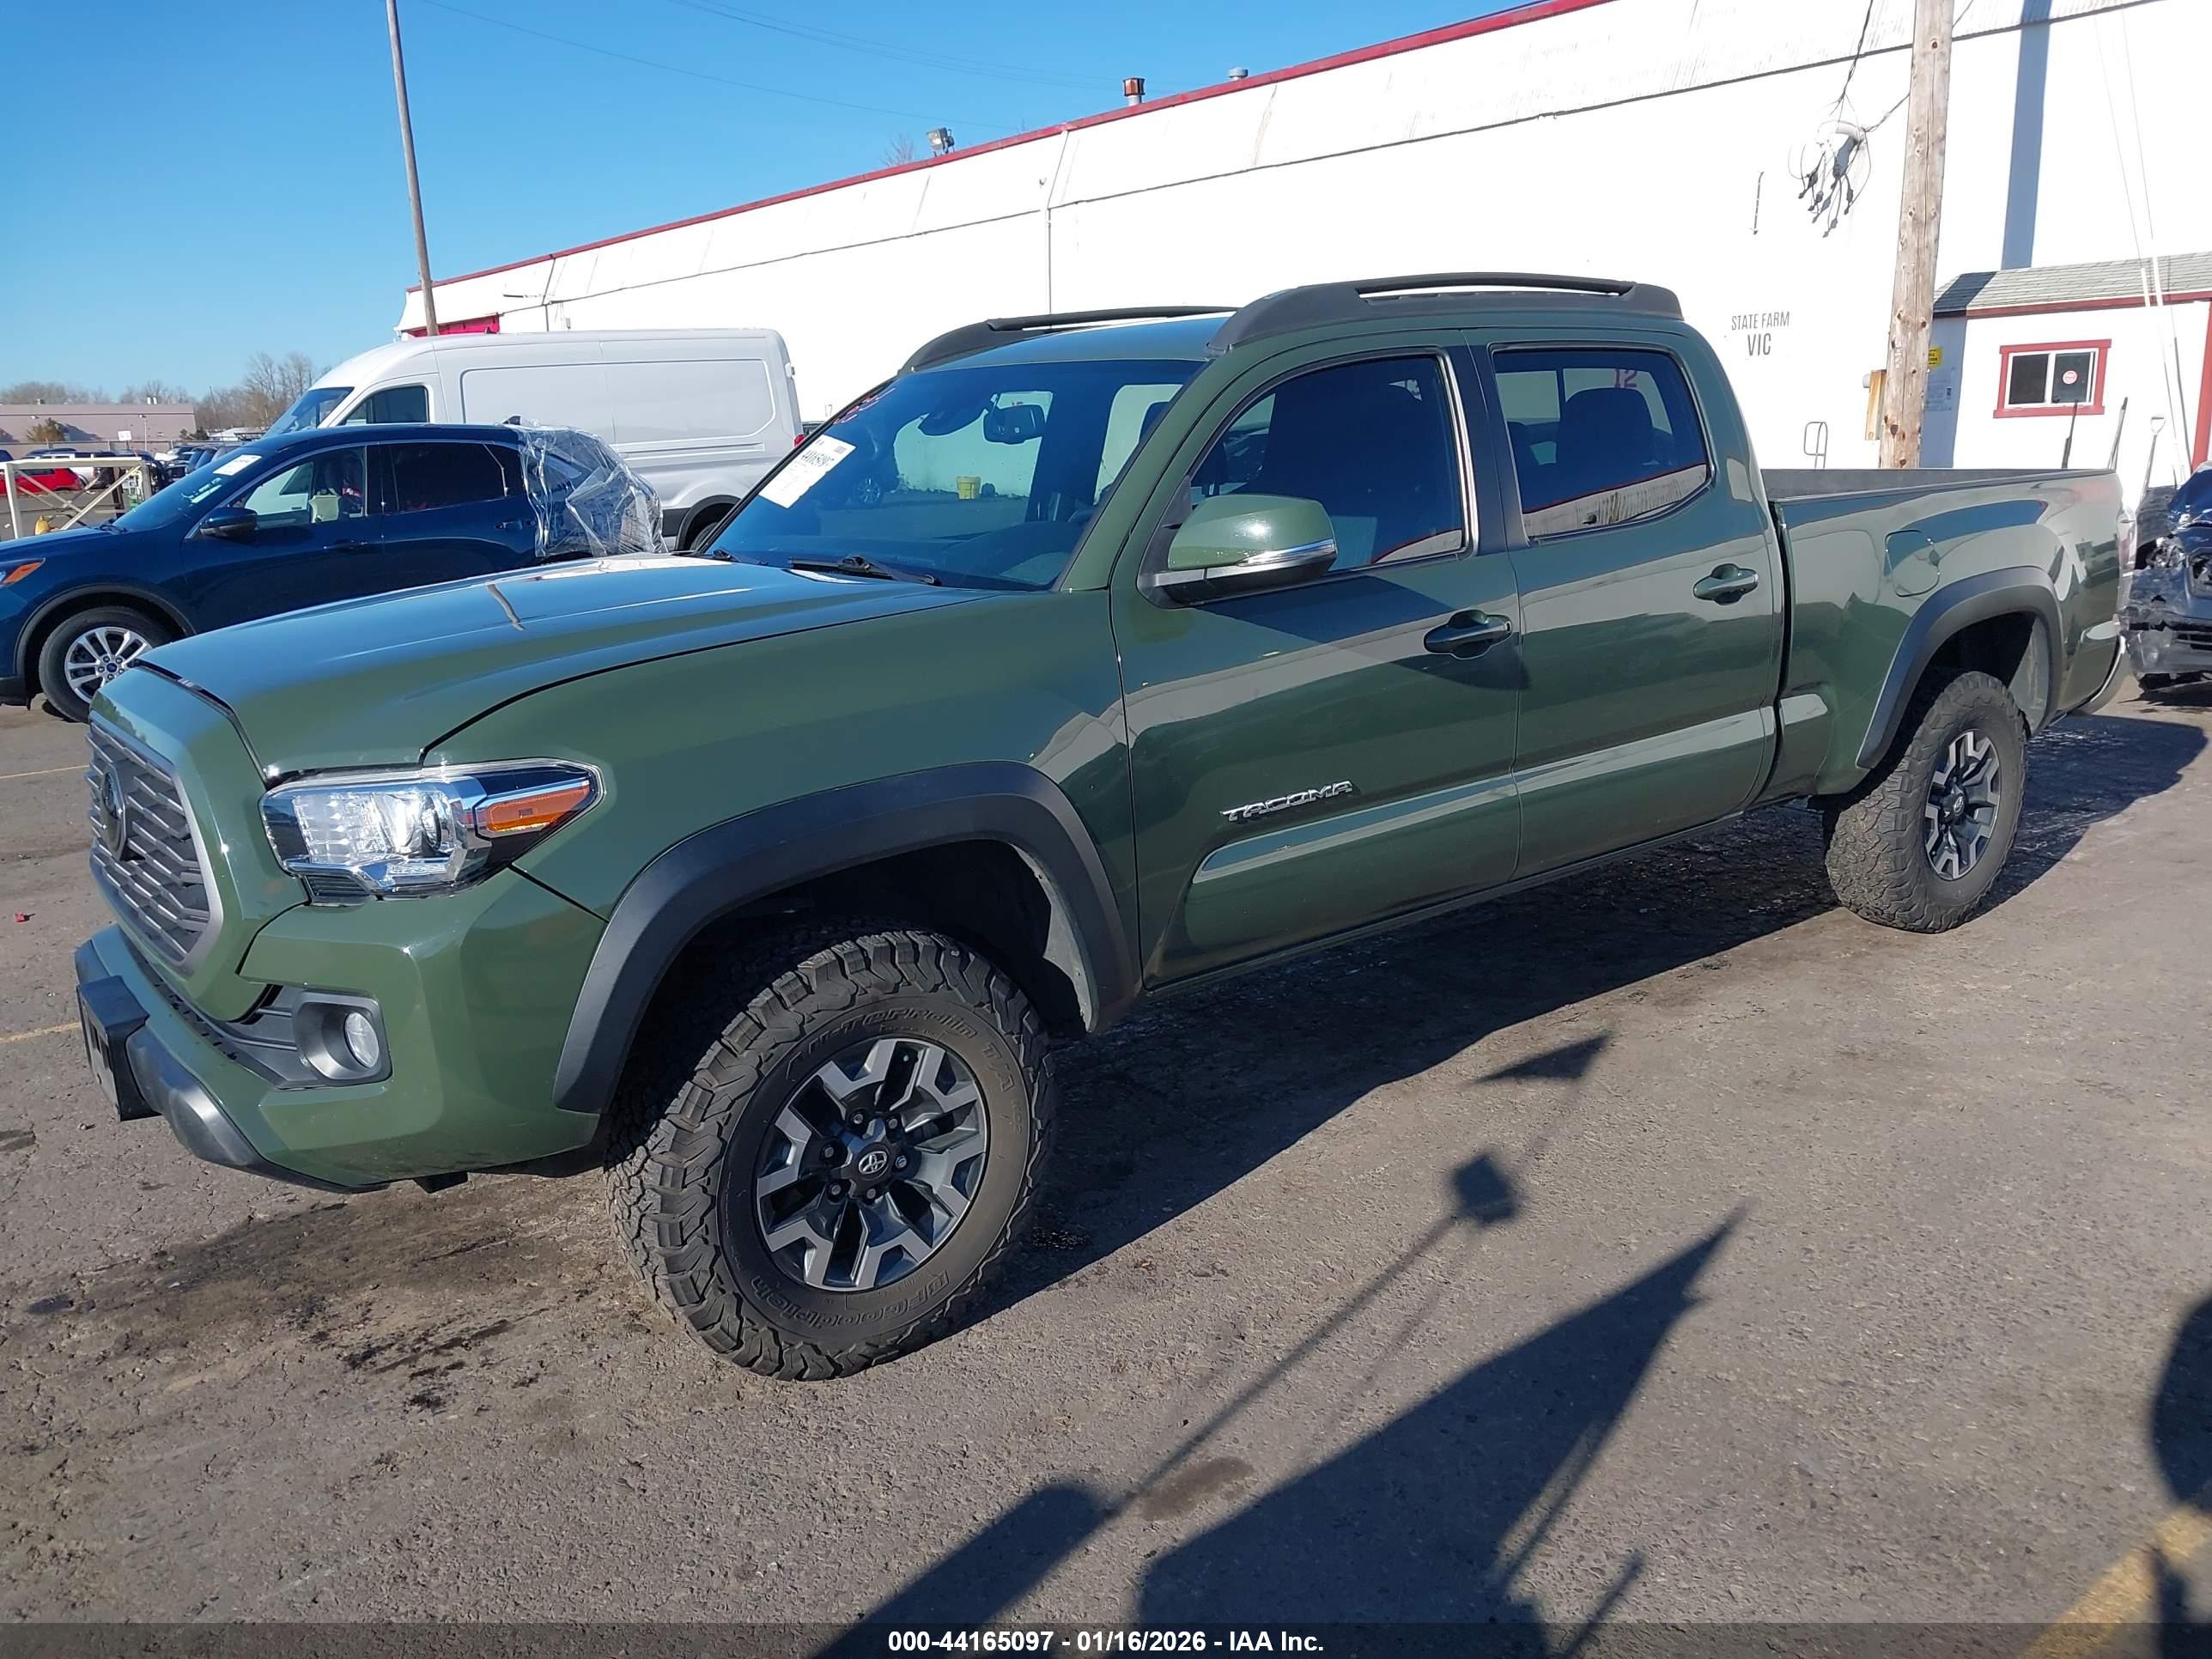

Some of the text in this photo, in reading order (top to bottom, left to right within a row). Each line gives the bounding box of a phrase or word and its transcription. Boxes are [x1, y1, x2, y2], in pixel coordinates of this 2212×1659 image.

[1731, 311, 1790, 331] STATE FARM
[1747, 332, 1771, 356] VIC
[1219, 780, 1353, 822] TACOMA
